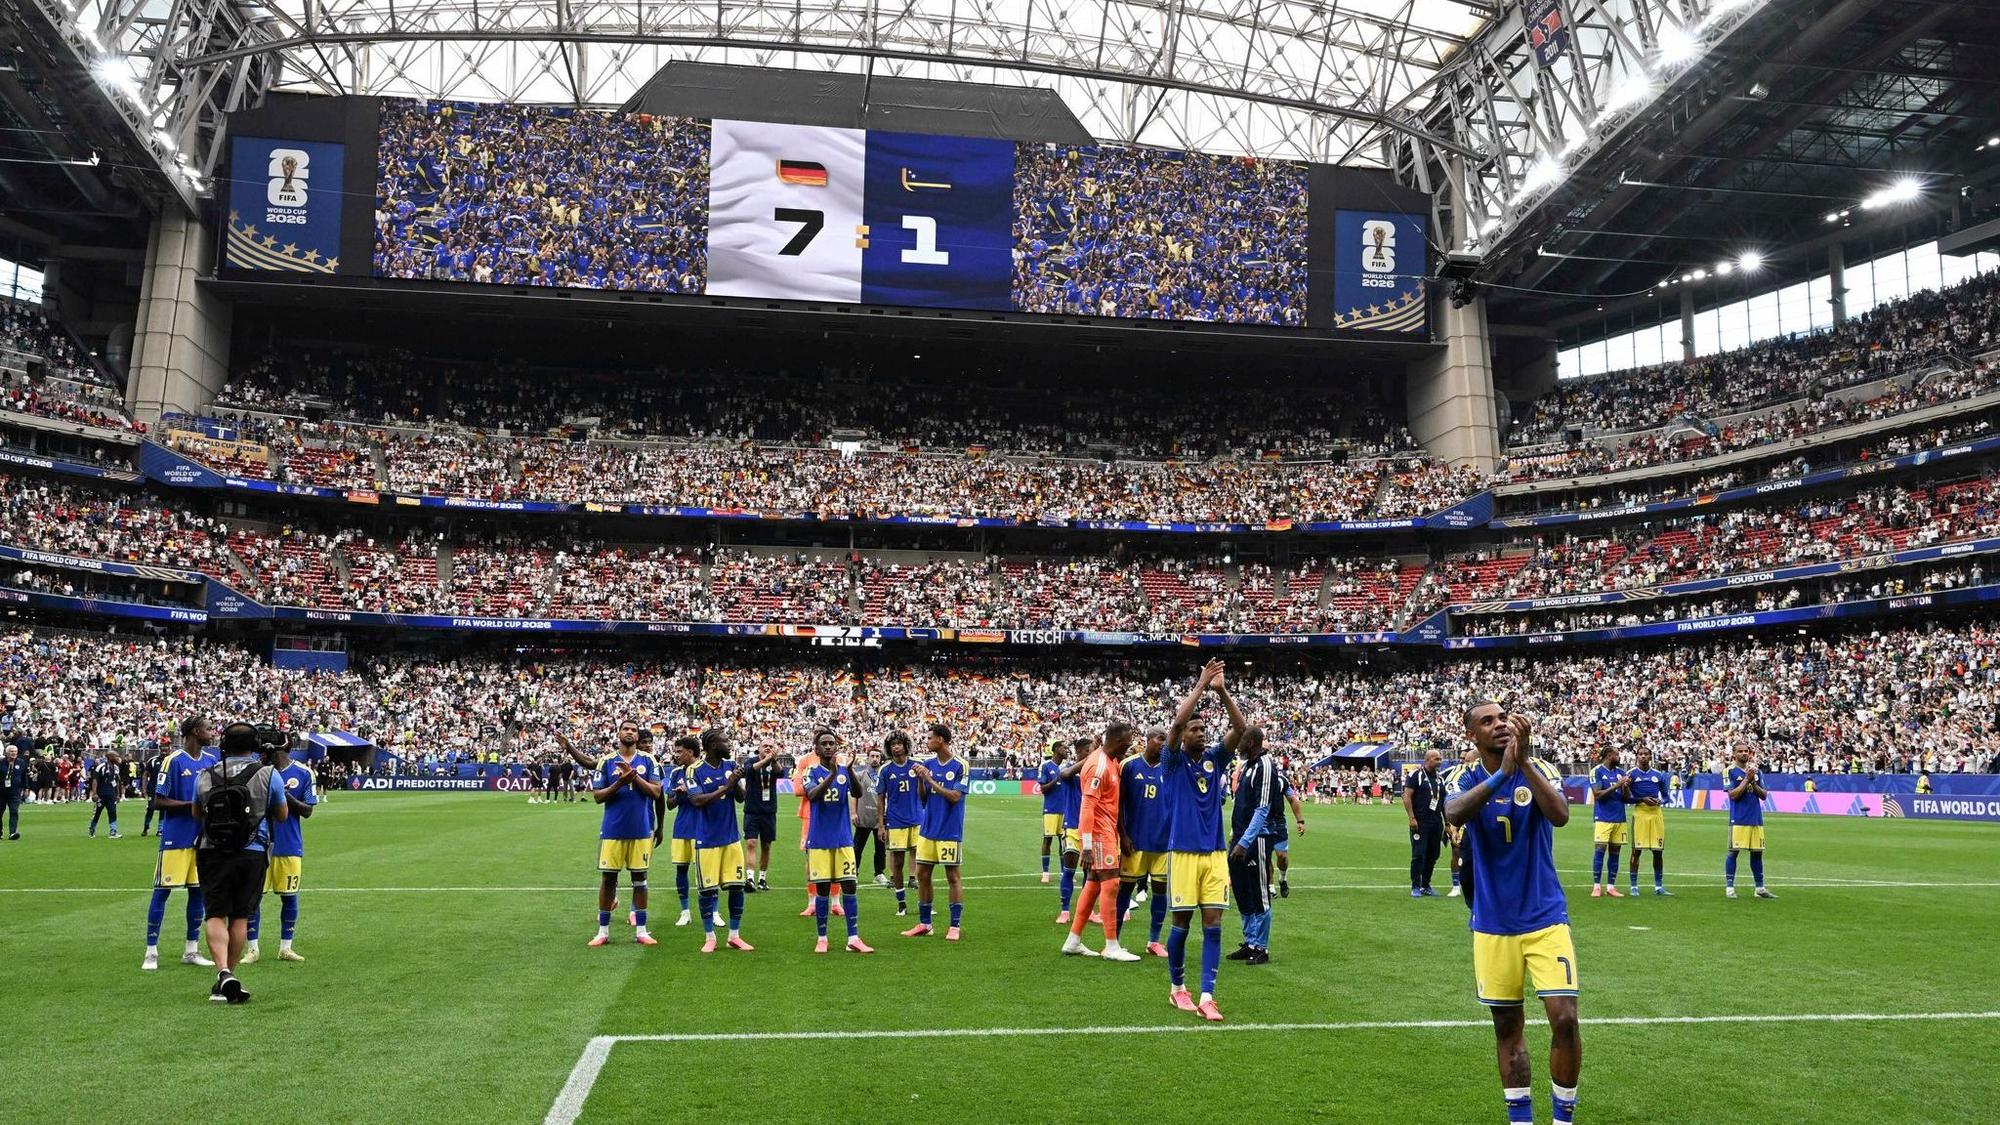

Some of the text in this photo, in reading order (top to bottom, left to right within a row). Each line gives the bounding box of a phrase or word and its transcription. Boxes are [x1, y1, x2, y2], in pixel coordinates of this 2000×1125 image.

[1544, 40, 1558, 61] 2011
[279, 194, 297, 202] FIFA
[266, 214, 307, 224] 2026
[774, 208, 824, 256] 7
[901, 215, 949, 266] 1
[1362, 279, 1395, 288] 2026
[11, 455, 24, 463] CUP
[26, 458, 52, 468] 2026
[1756, 480, 1802, 493] HOUSTON
[1578, 512, 1593, 520] FIFA
[1593, 510, 1613, 519] WORLD
[22, 552, 102, 569] FIFA WORLD CUP 2026
[1728, 573, 1774, 585] HOUSTON
[1890, 596, 1932, 608] HOUSTON
[307, 611, 350, 620] HOUSTON
[454, 619, 551, 629] FIFA WORLD CUP 2026
[648, 624, 690, 632] HOUSTON
[1678, 616, 1755, 630] FIFA WORLD CUP 2026
[841, 627, 882, 638] 7 1
[1011, 630, 1062, 644] KETSCH
[1529, 635, 1563, 644] HOUSTON
[363, 779, 484, 788] ADI PREDICTSTREET
[496, 778, 549, 792] QATR
[900, 780, 909, 792] 21
[824, 789, 839, 802] 22
[1144, 785, 1157, 799] 19
[1914, 800, 1938, 813] FIFA
[1940, 801, 1985, 815] WORLD
[941, 848, 955, 860] 24
[736, 866, 743, 880] 5
[286, 875, 299, 890] 13
[1558, 956, 1572, 984] 7
